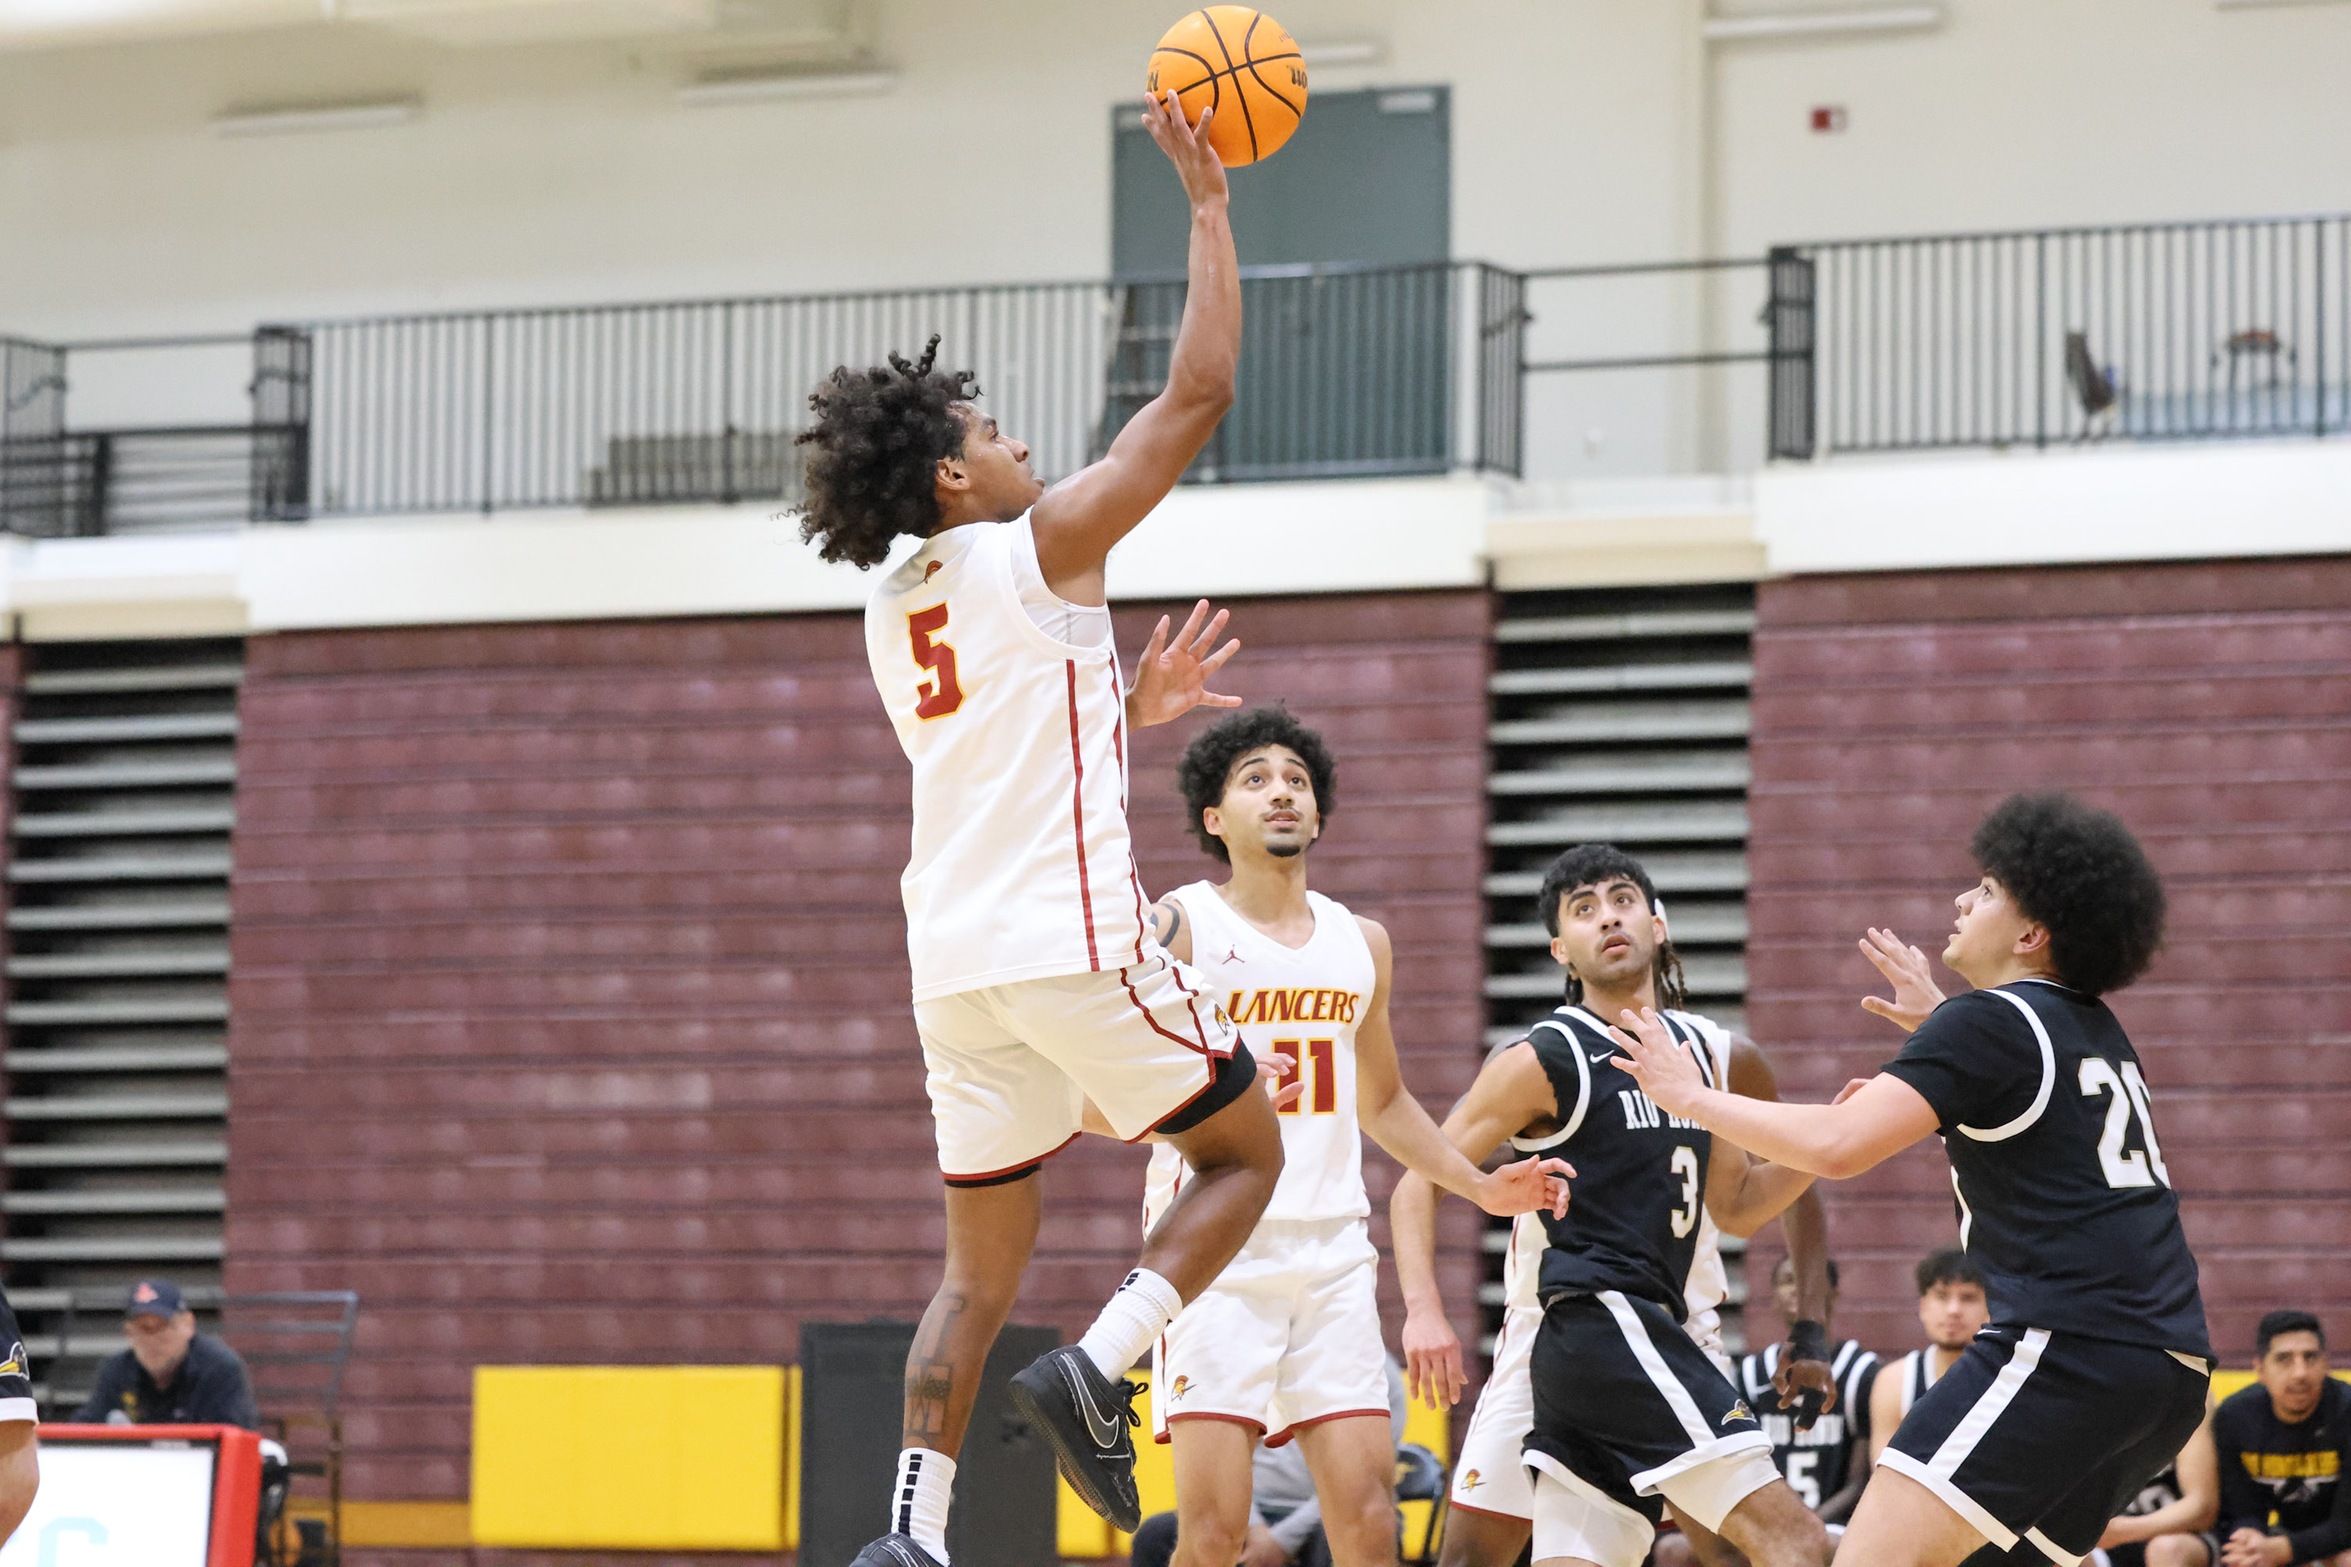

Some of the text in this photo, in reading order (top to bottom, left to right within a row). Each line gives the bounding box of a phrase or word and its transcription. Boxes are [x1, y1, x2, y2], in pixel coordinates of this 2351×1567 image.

[906, 600, 966, 722] 5
[1227, 987, 1360, 1025] LANCERS
[1271, 1037, 1337, 1116] 11
[1618, 1089, 1660, 1130] RIO
[1670, 1145, 1700, 1239] 3
[1786, 1451, 1821, 1509] 5
